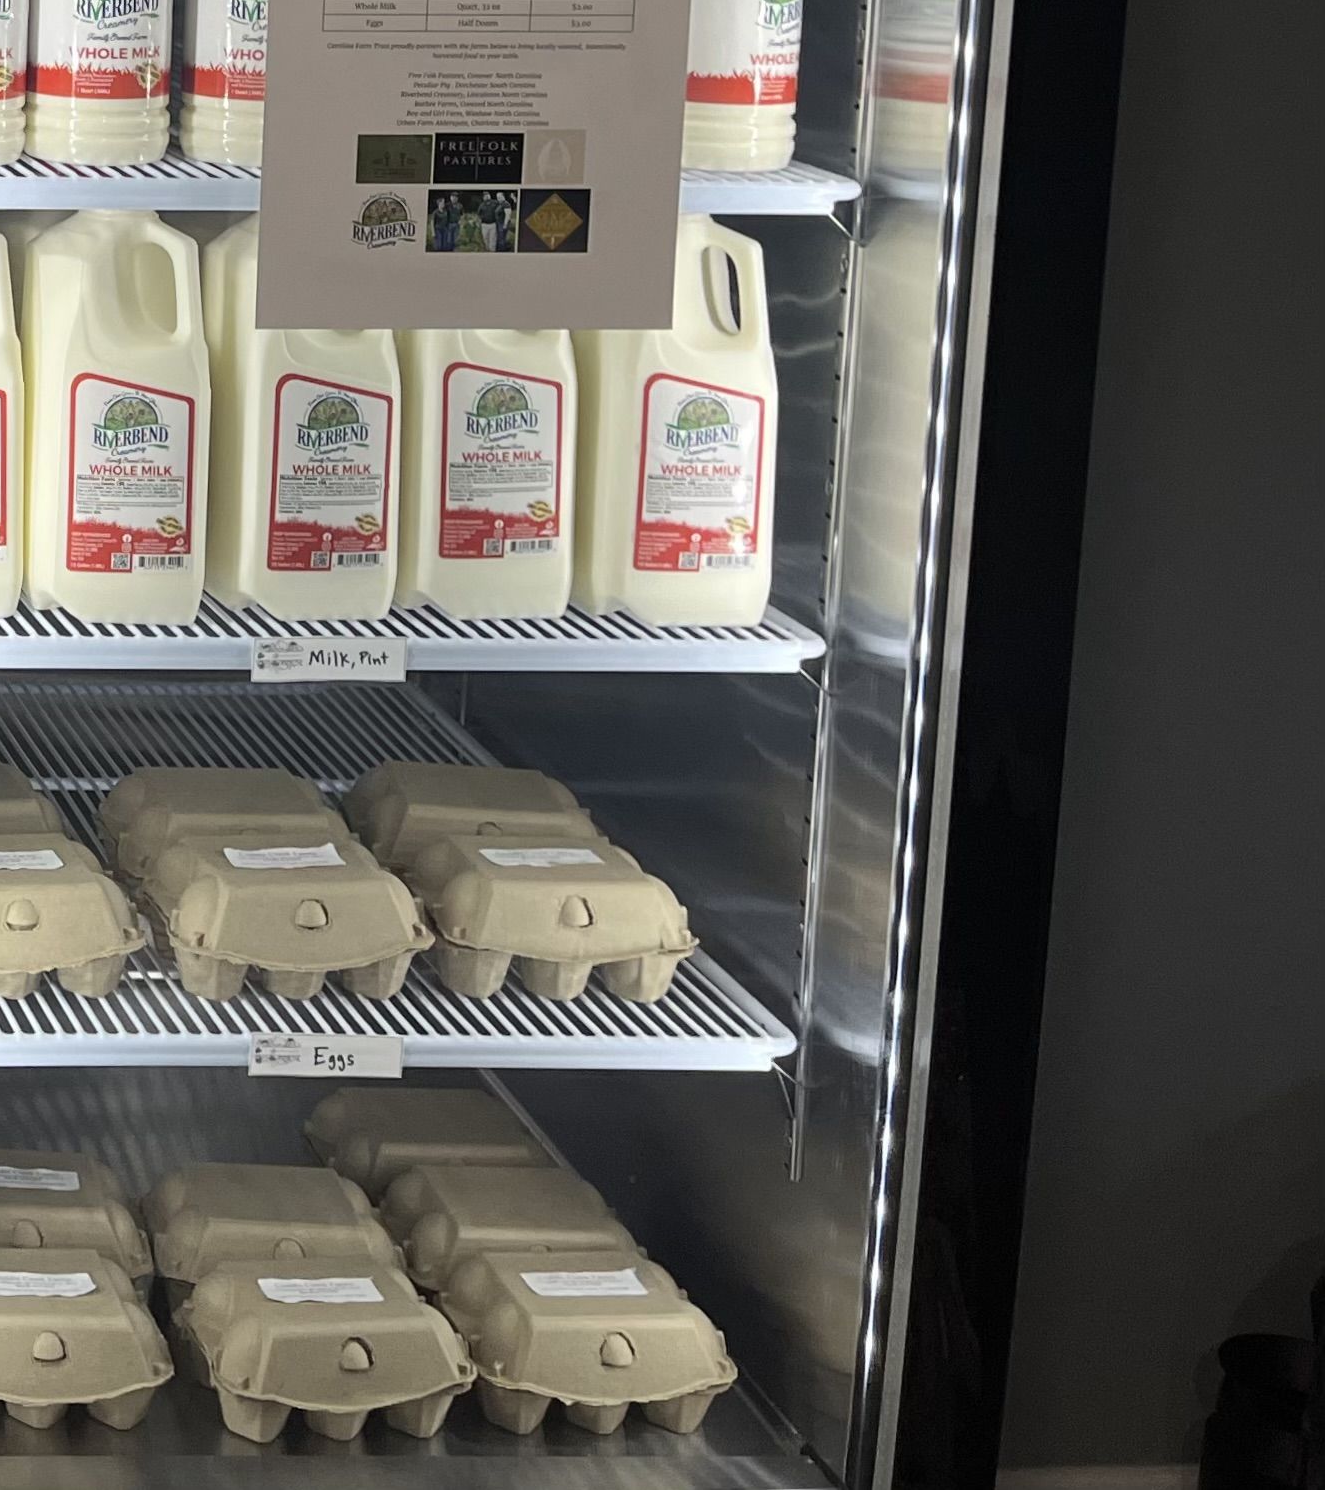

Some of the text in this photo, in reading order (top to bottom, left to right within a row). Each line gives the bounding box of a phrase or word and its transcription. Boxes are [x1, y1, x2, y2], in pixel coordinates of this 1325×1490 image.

[68, 45, 161, 60] WHOLE MILK
[225, 48, 265, 62] WHO
[750, 54, 795, 65] WHOLE
[443, 155, 512, 166] PASTURES
[353, 223, 416, 242] RIVERBEND
[466, 412, 539, 435] RIVERBEND
[93, 427, 169, 447] RIVERBEND
[298, 425, 369, 448] RIVERBEND
[666, 425, 739, 448] RIVERBEND
[463, 451, 542, 463] WHOLE MILK
[89, 465, 172, 477] WHOLE MILK
[292, 464, 371, 476] WHOLE MILK
[660, 464, 742, 476] WHOLE MILK
[309, 650, 355, 669] Milk,
[314, 1047, 354, 1071] Eggs
